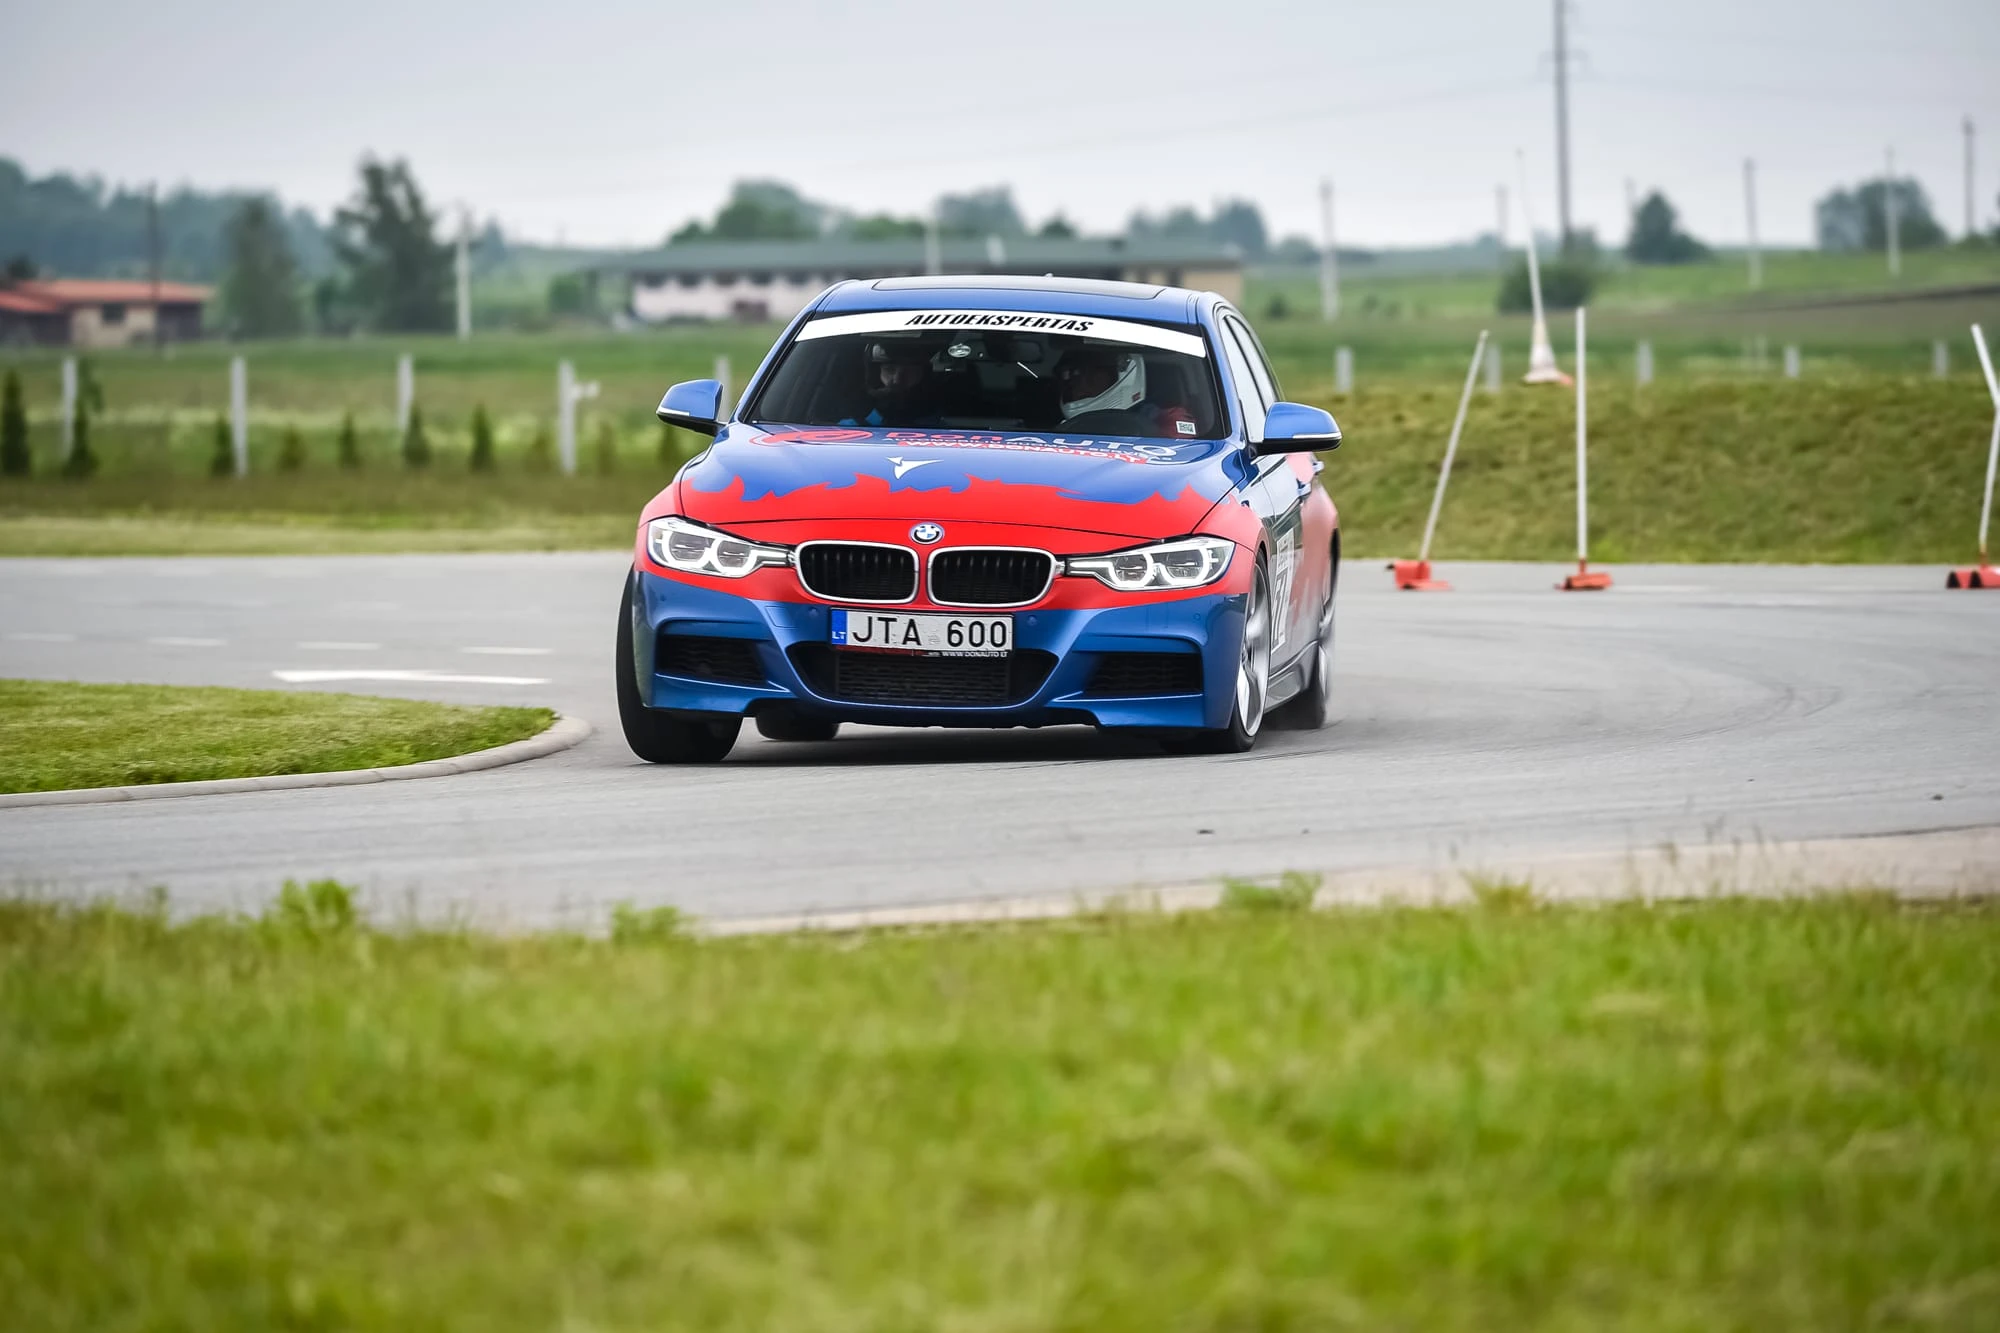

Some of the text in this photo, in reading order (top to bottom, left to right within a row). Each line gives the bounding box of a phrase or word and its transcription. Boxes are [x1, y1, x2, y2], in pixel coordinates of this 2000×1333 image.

[905, 314, 1094, 332] AUTOEKSPERTAS
[905, 441, 1143, 463] WWW.DONAUTO.LT
[832, 615, 1007, 648] LT JTA 600
[941, 650, 1008, 658] WWWDONAUTOLT
